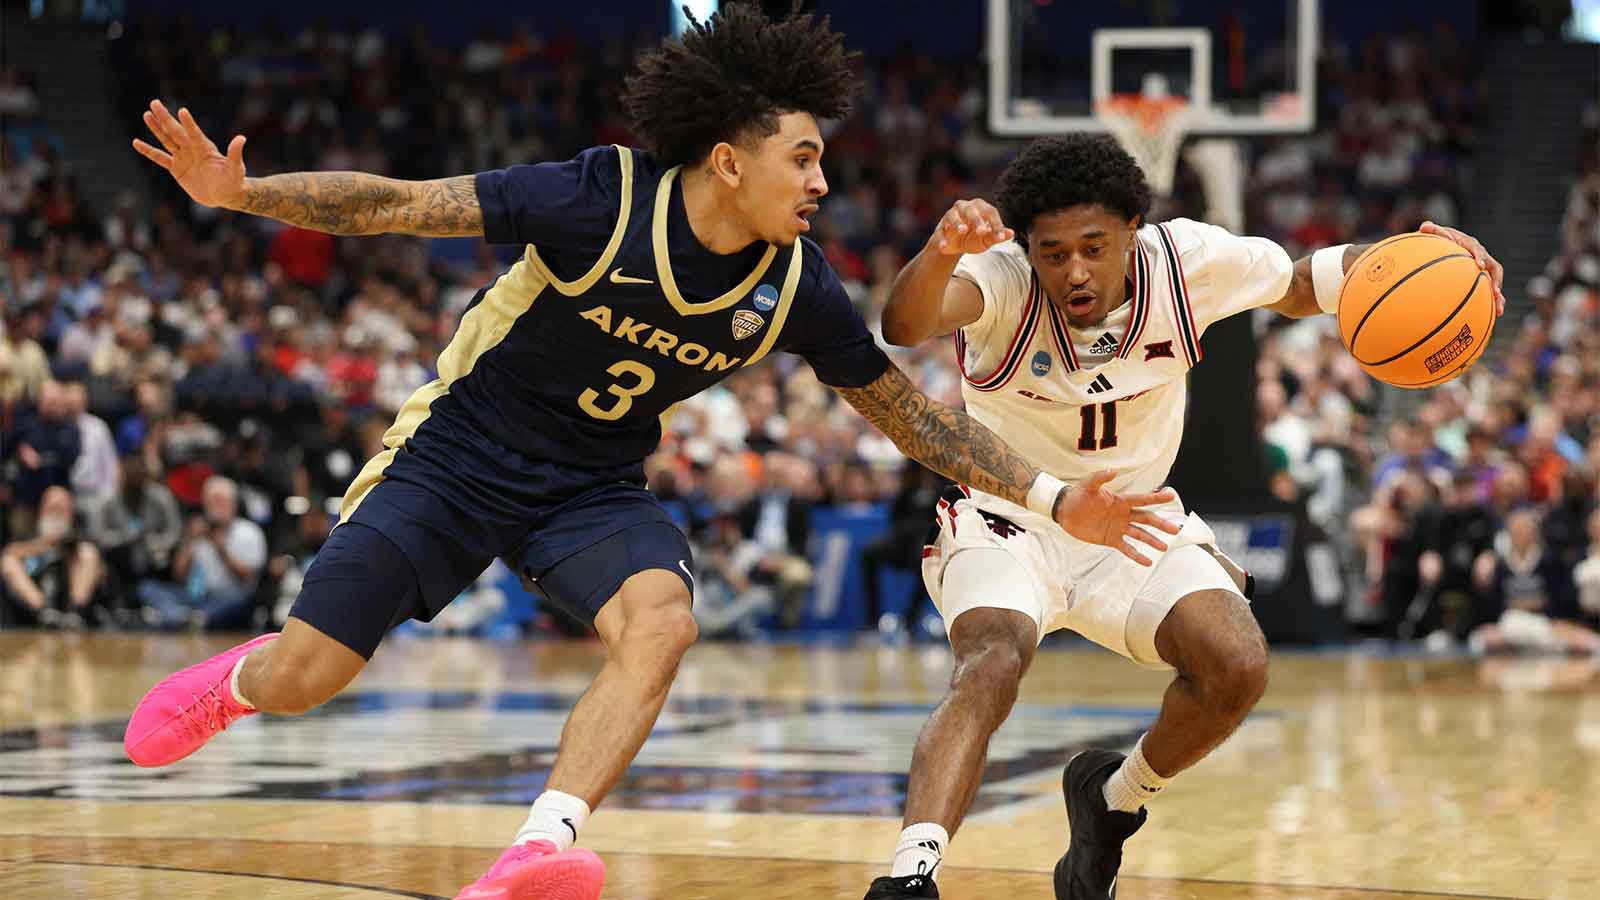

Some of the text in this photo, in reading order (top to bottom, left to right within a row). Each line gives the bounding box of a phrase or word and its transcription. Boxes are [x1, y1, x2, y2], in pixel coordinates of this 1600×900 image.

[579, 305, 741, 371] AKRON
[1090, 343, 1119, 354] adida
[577, 360, 655, 420] 3
[1077, 400, 1118, 451] 11
